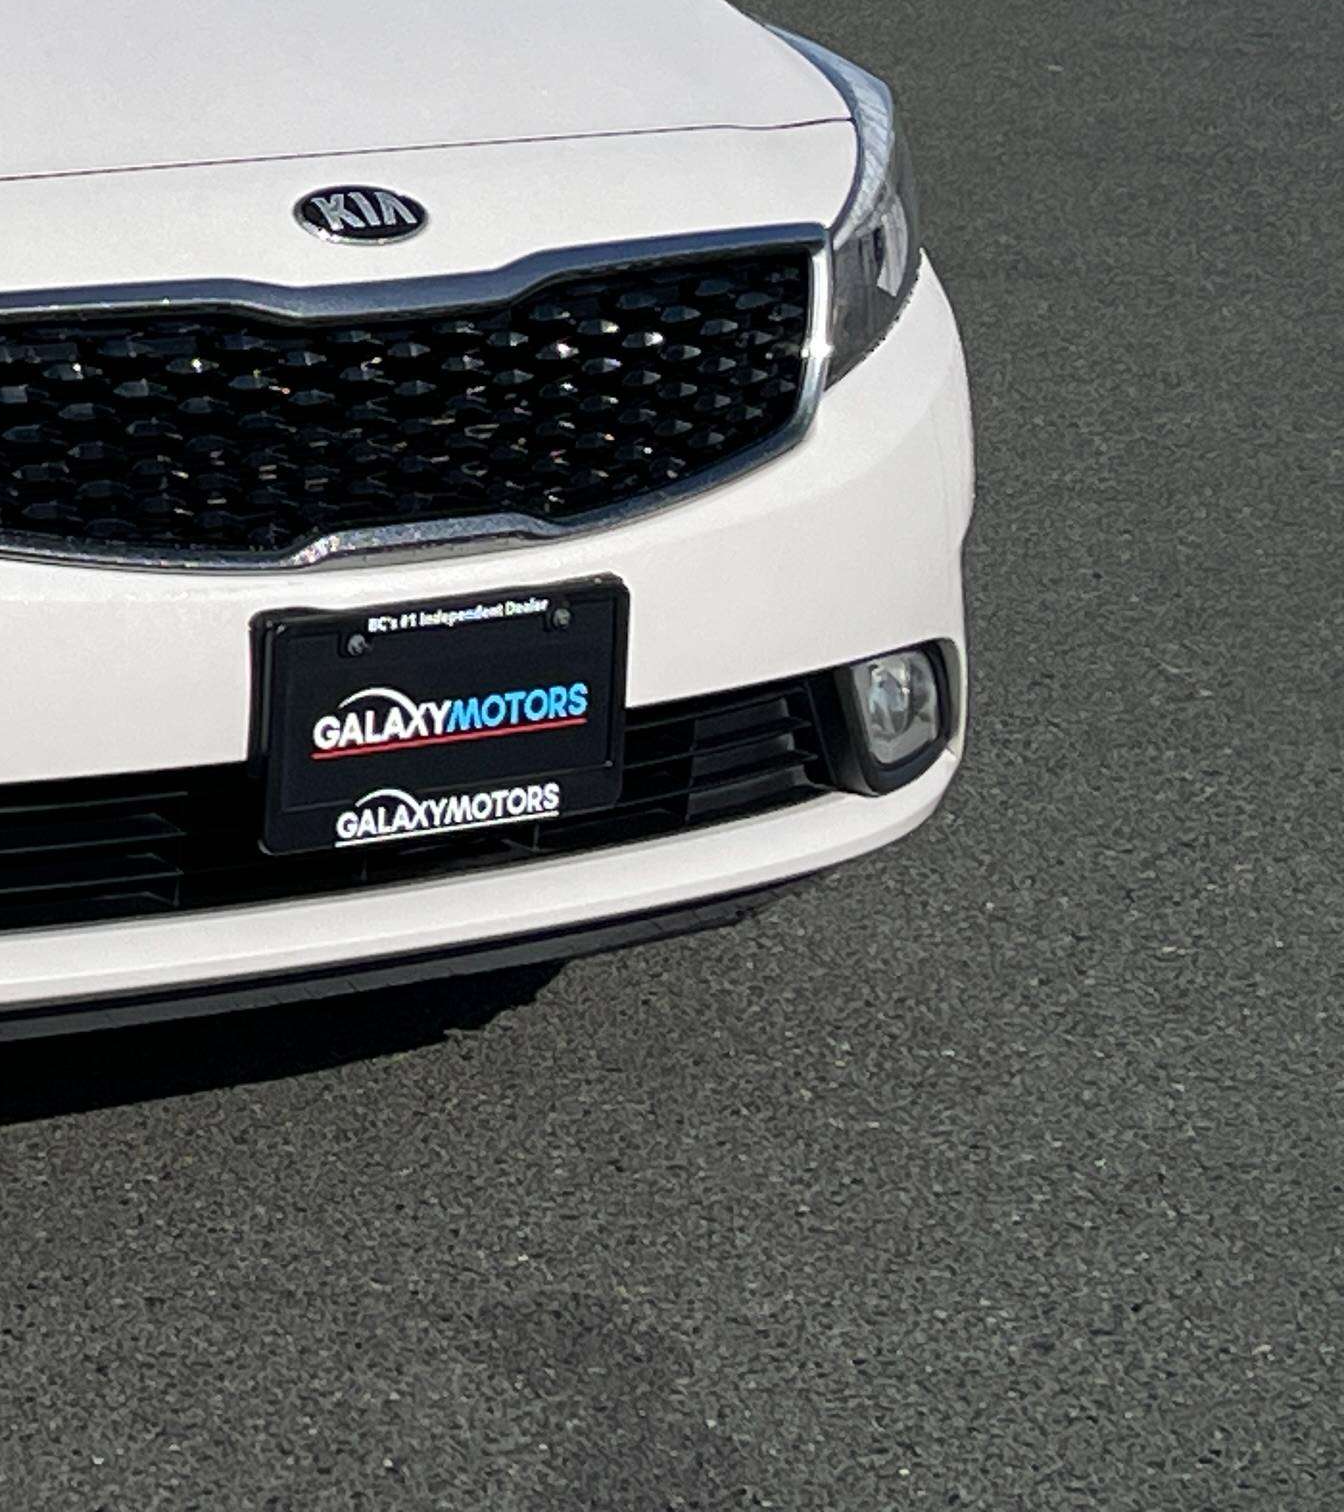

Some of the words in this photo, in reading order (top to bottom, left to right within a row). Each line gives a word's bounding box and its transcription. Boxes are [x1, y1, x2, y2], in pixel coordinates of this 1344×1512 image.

[311, 191, 417, 231] KIA
[368, 616, 398, 633] BC's
[419, 604, 503, 627] Independent
[505, 597, 549, 616] Dealer
[313, 682, 589, 750] GALAXYMOTORS
[336, 783, 559, 840] GALAXYMOTORS
